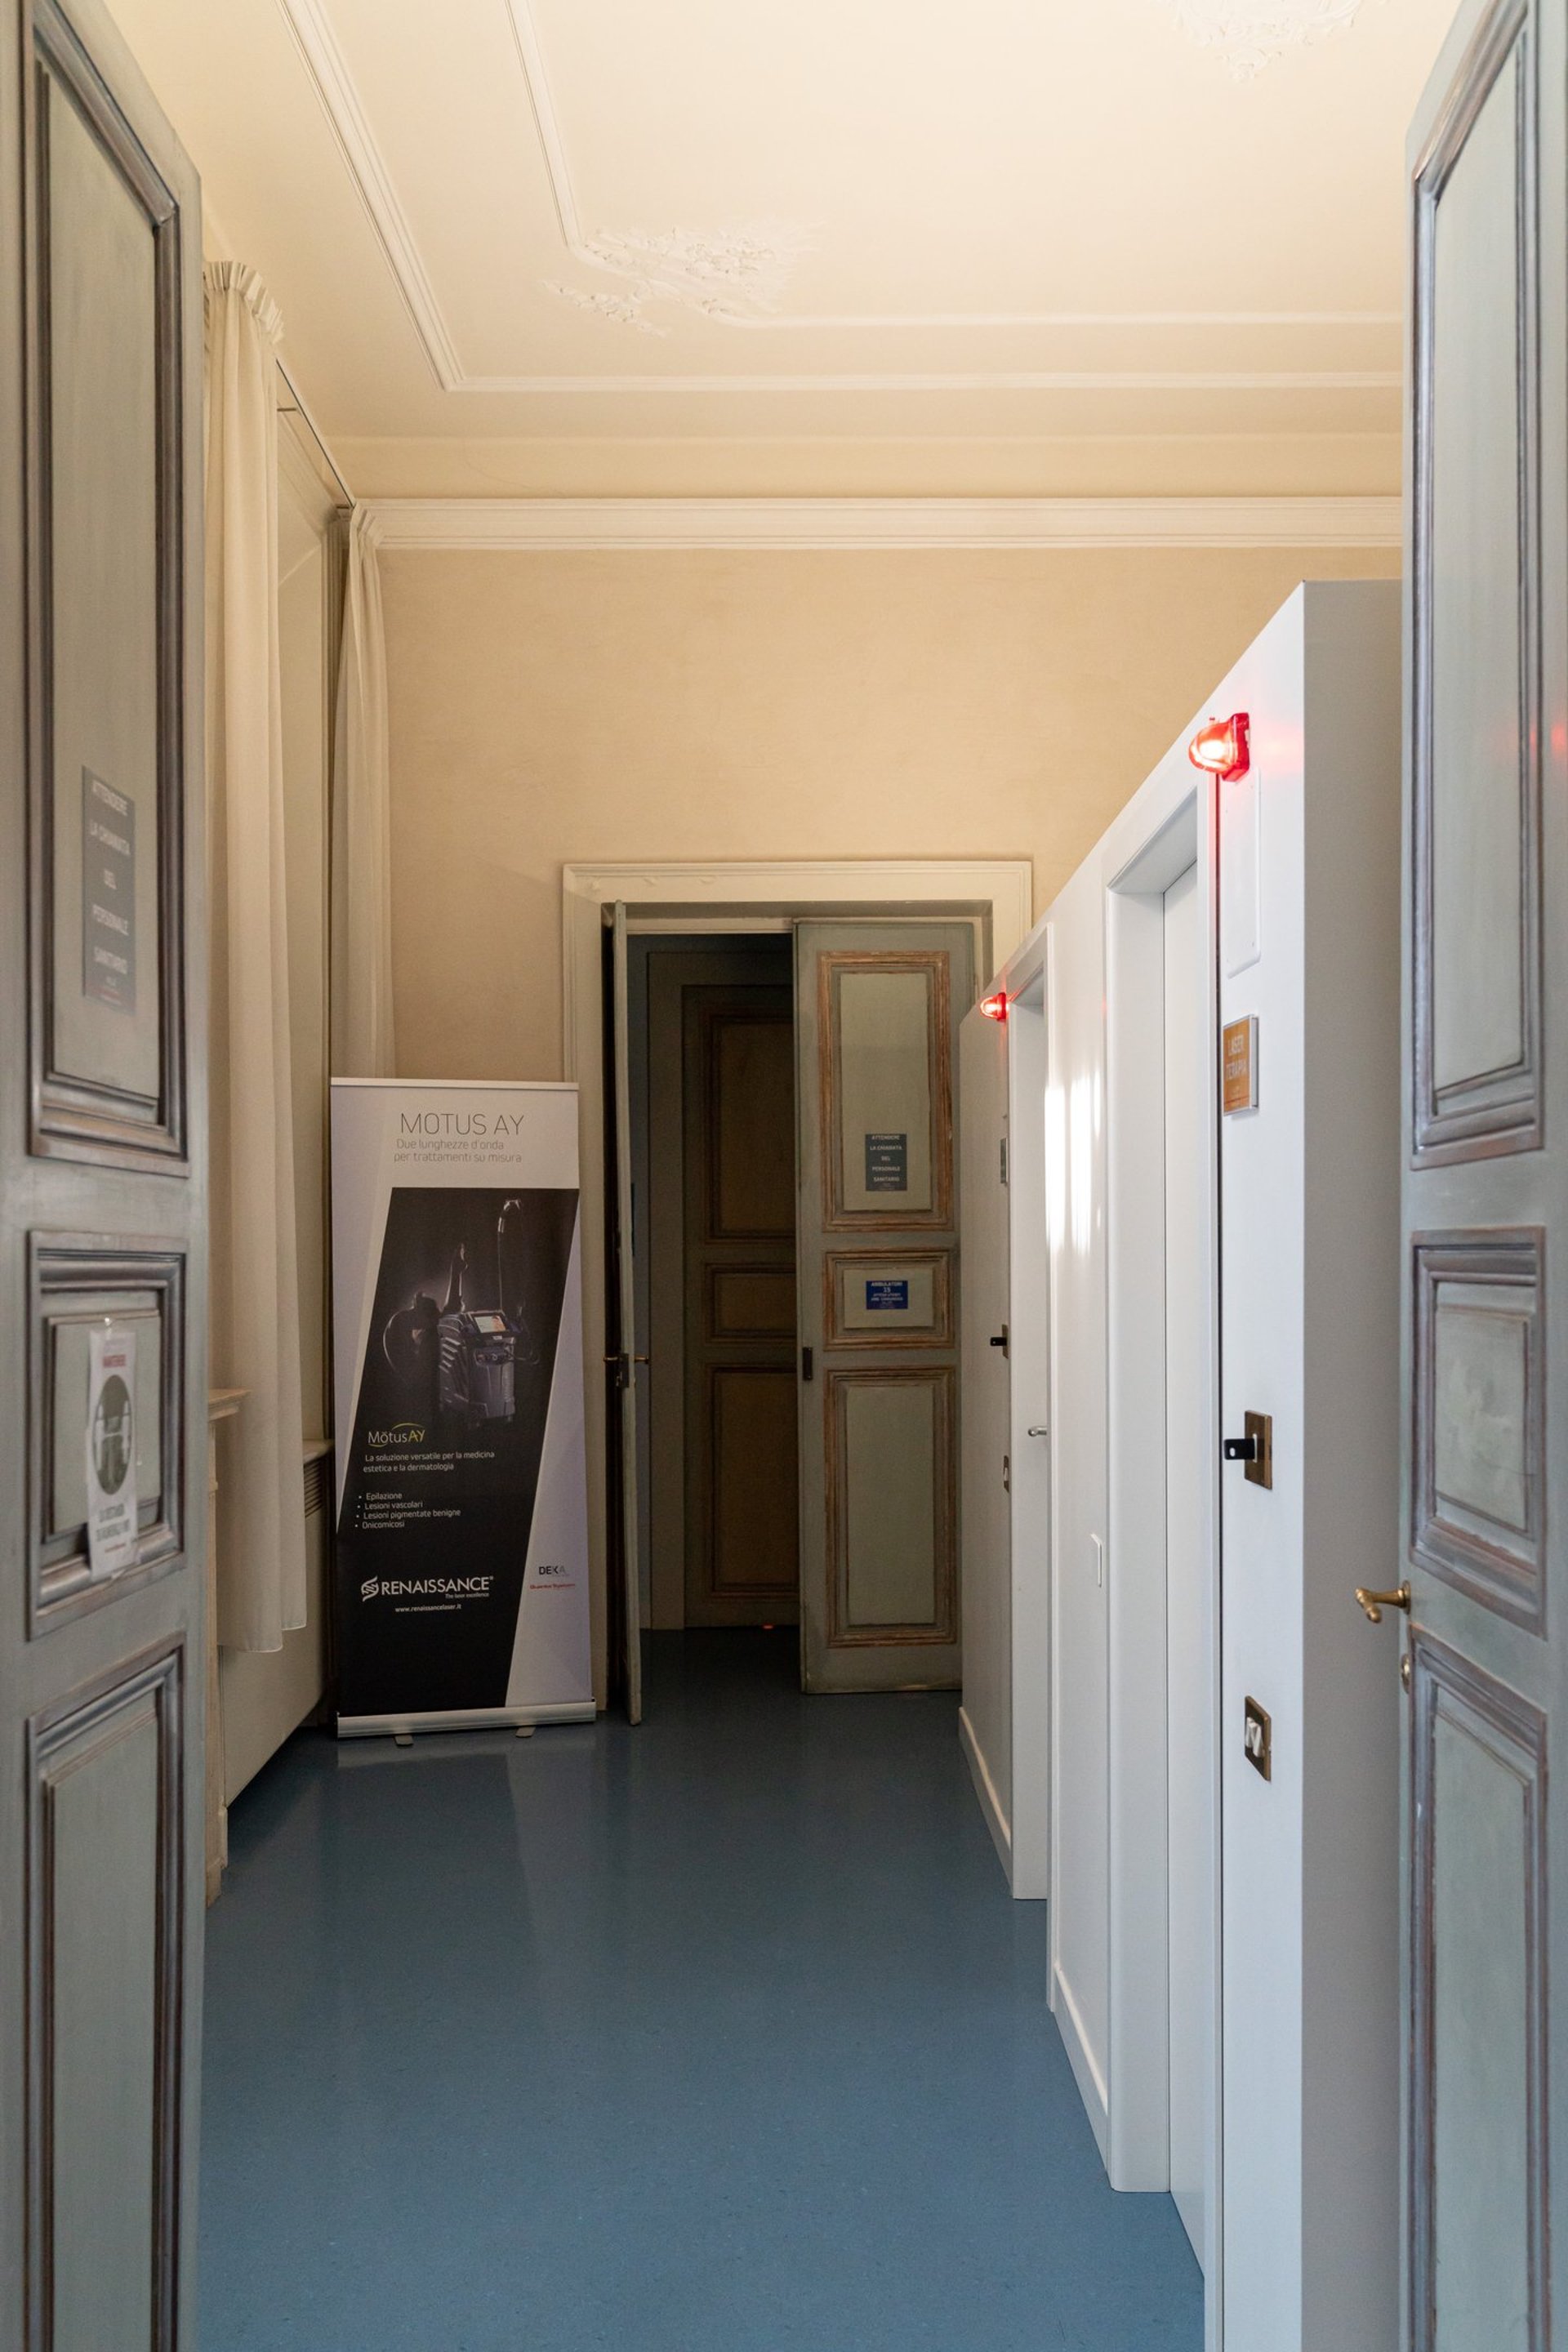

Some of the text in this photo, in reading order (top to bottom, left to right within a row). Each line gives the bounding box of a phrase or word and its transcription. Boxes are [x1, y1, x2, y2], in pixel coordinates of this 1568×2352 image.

[401, 1112, 524, 1135] MOTUS AY
[396, 1138, 504, 1152] Due lunghezze d'onda
[394, 1152, 522, 1163] per trattamenti su misura
[376, 1452, 409, 1462] soluzione
[410, 1451, 441, 1460] versatile
[442, 1452, 455, 1461] per
[456, 1450, 463, 1459] la
[464, 1450, 495, 1459] medicina
[363, 1464, 392, 1472] estetica
[399, 1463, 406, 1471] la
[408, 1462, 454, 1472] dermatologia
[366, 1492, 403, 1501] Epilazione
[364, 1501, 423, 1510] Lesioni vascolari
[363, 1509, 461, 1520] Lesioni pigmentate benigne
[362, 1521, 405, 1530] Onicomicosi
[394, 1603, 462, 1613] www.renaissancelaser.it
